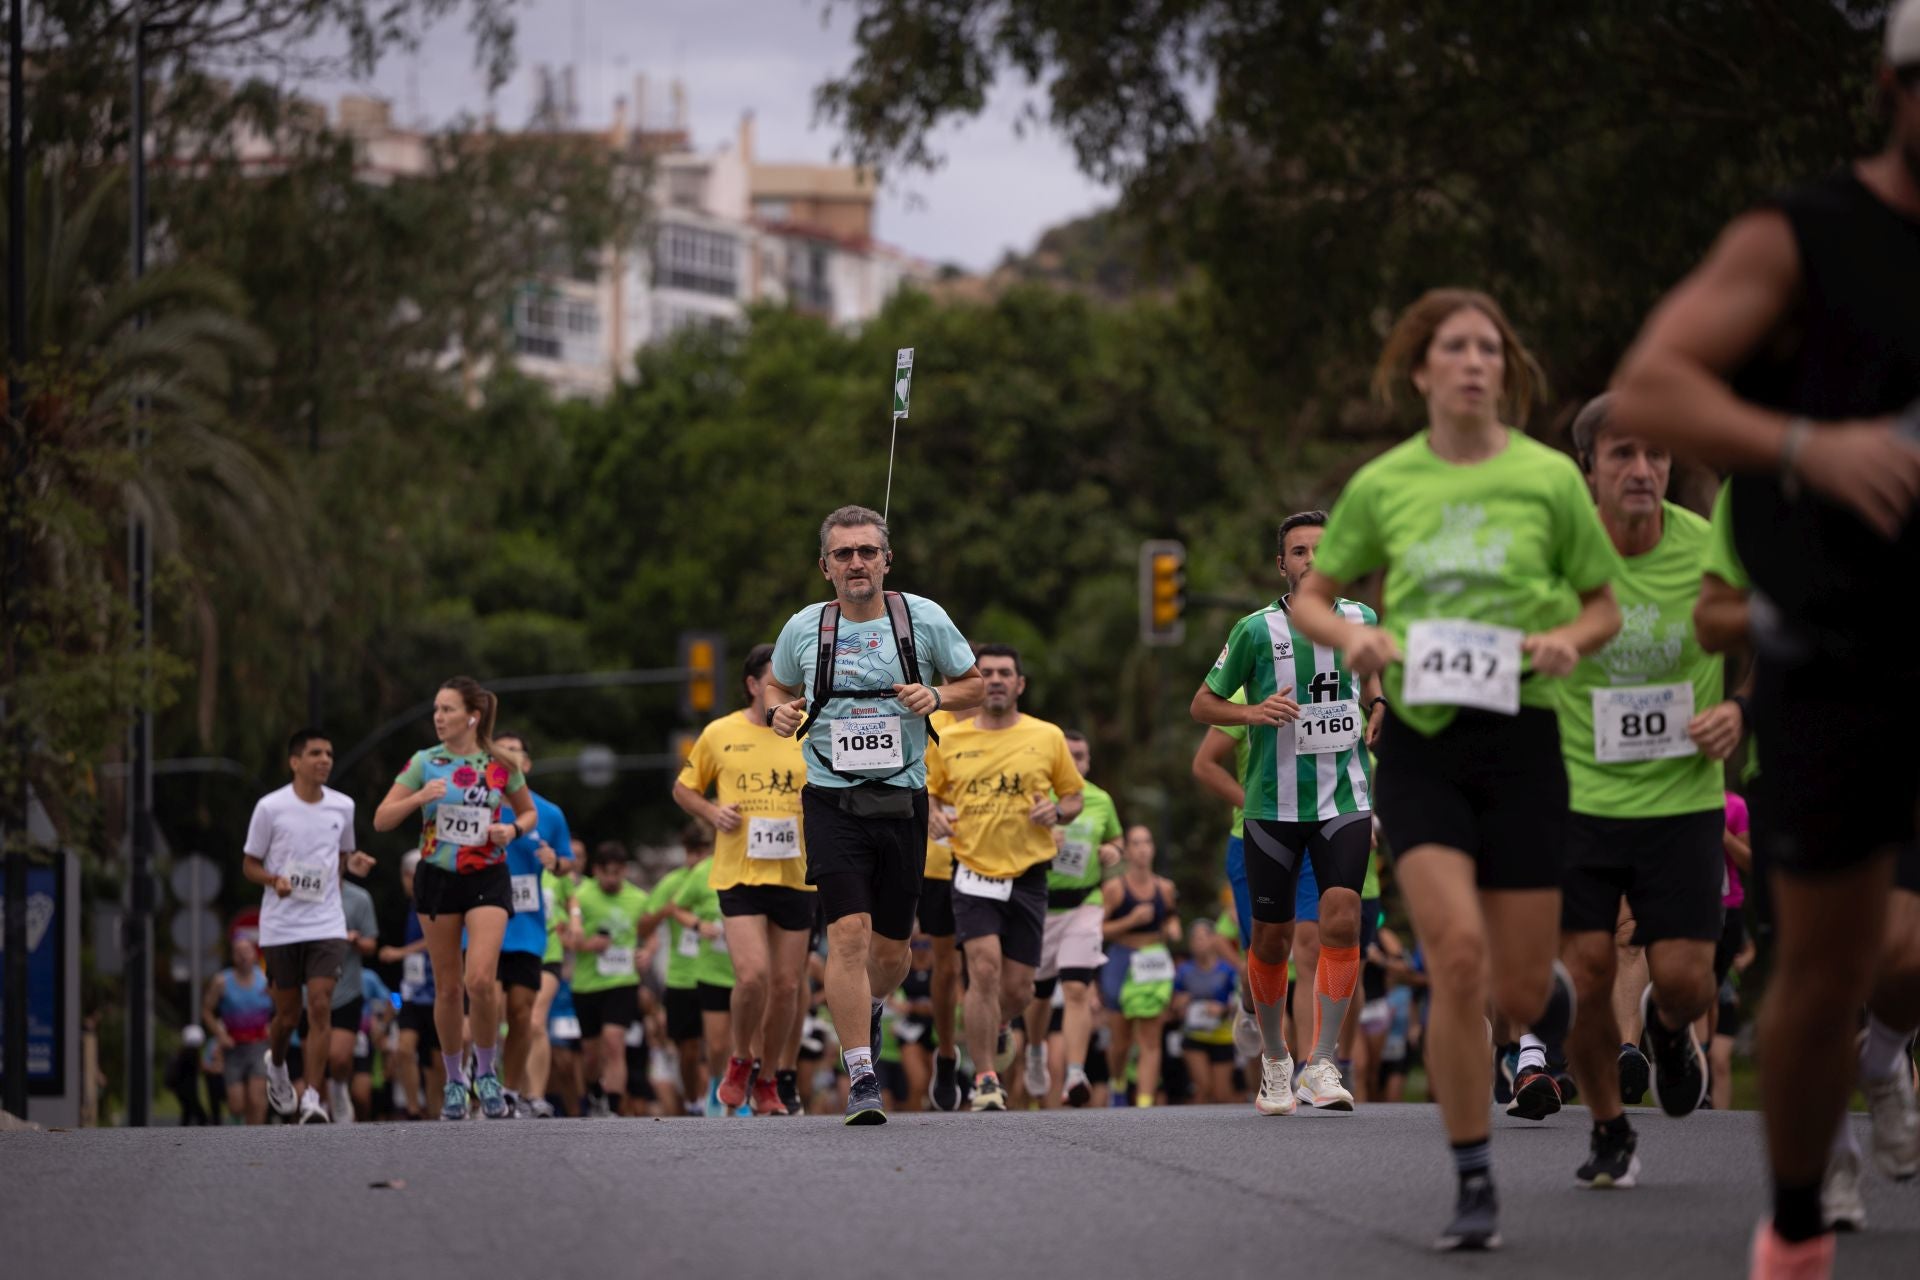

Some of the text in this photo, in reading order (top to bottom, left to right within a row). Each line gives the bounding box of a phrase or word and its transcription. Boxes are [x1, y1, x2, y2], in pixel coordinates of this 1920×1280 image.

[1422, 646, 1498, 680] 447
[851, 707, 879, 715] MEMORIAL
[1302, 716, 1354, 736] 1160
[1621, 711, 1667, 738] 80
[838, 733, 894, 752] 1083
[736, 773, 764, 792] 45
[444, 817, 480, 834] 701
[754, 831, 795, 844] 1146
